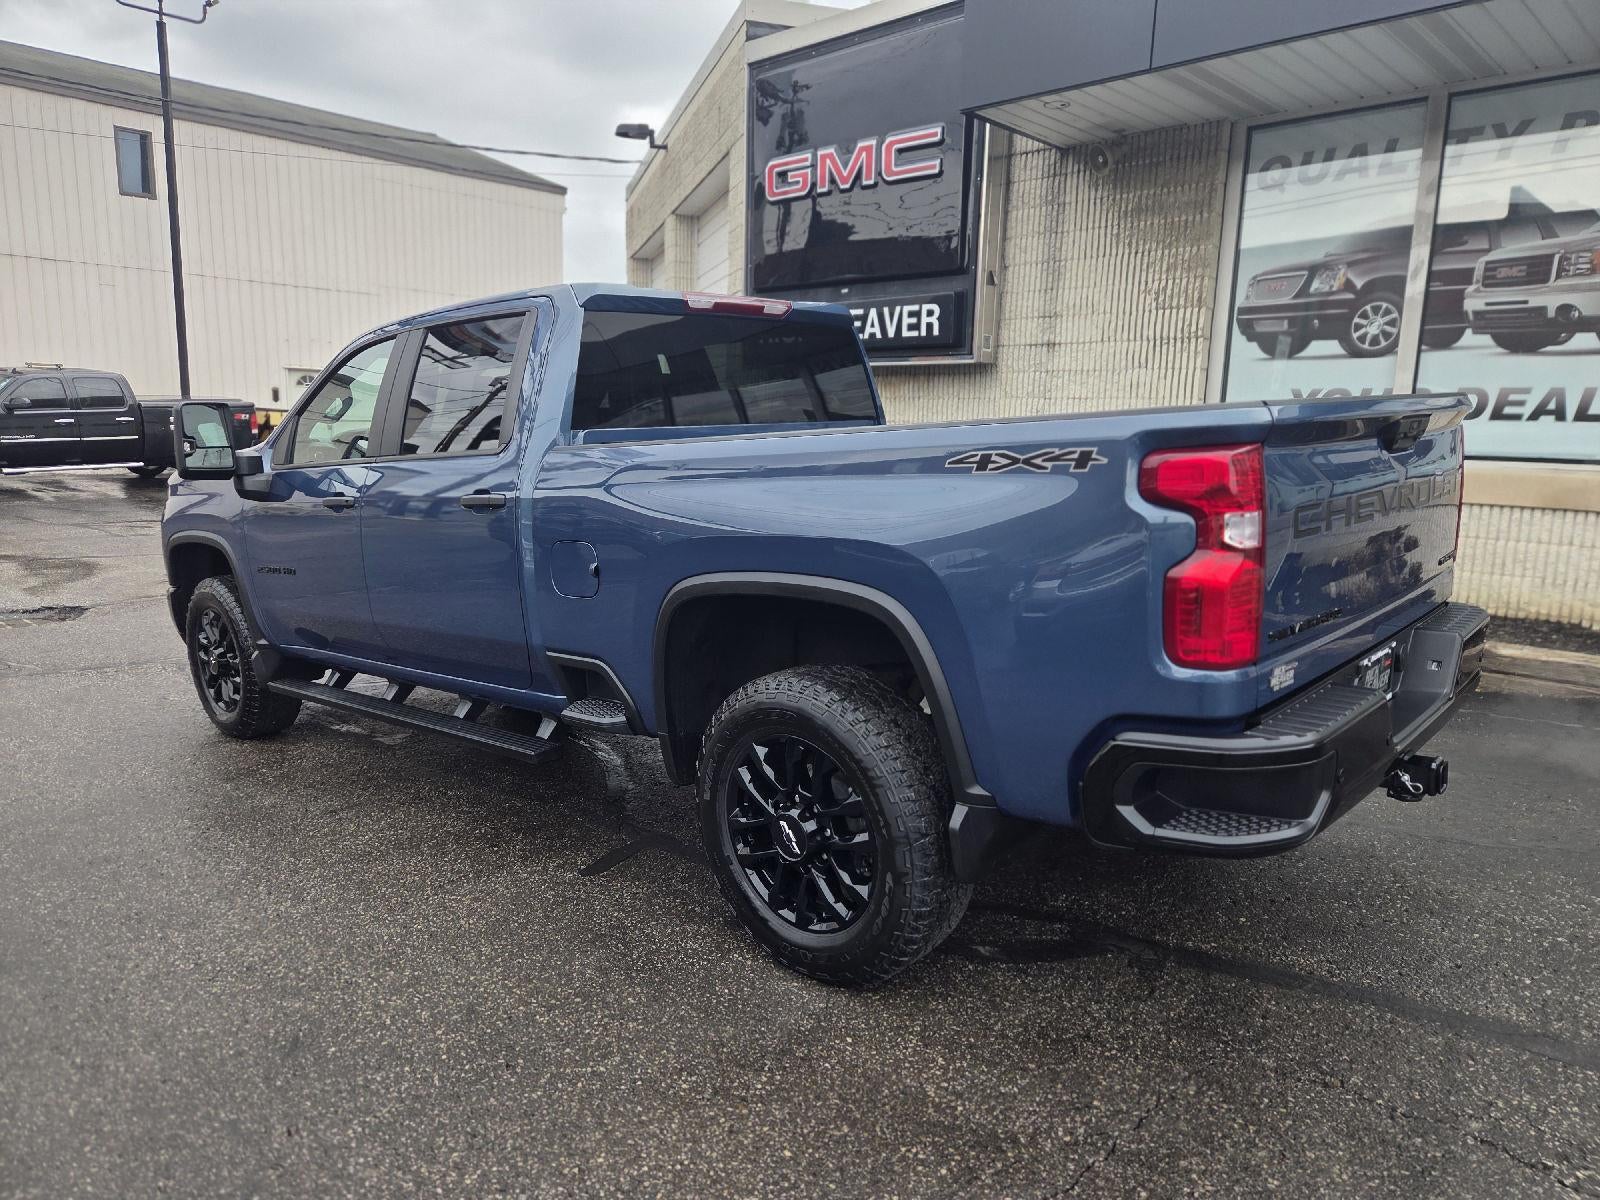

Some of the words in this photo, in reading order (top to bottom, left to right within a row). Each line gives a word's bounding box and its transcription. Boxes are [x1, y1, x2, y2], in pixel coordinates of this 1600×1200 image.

[765, 123, 945, 202] GMC
[1256, 117, 1537, 195] QUALTY
[1292, 464, 1458, 540] CHEVROLET
